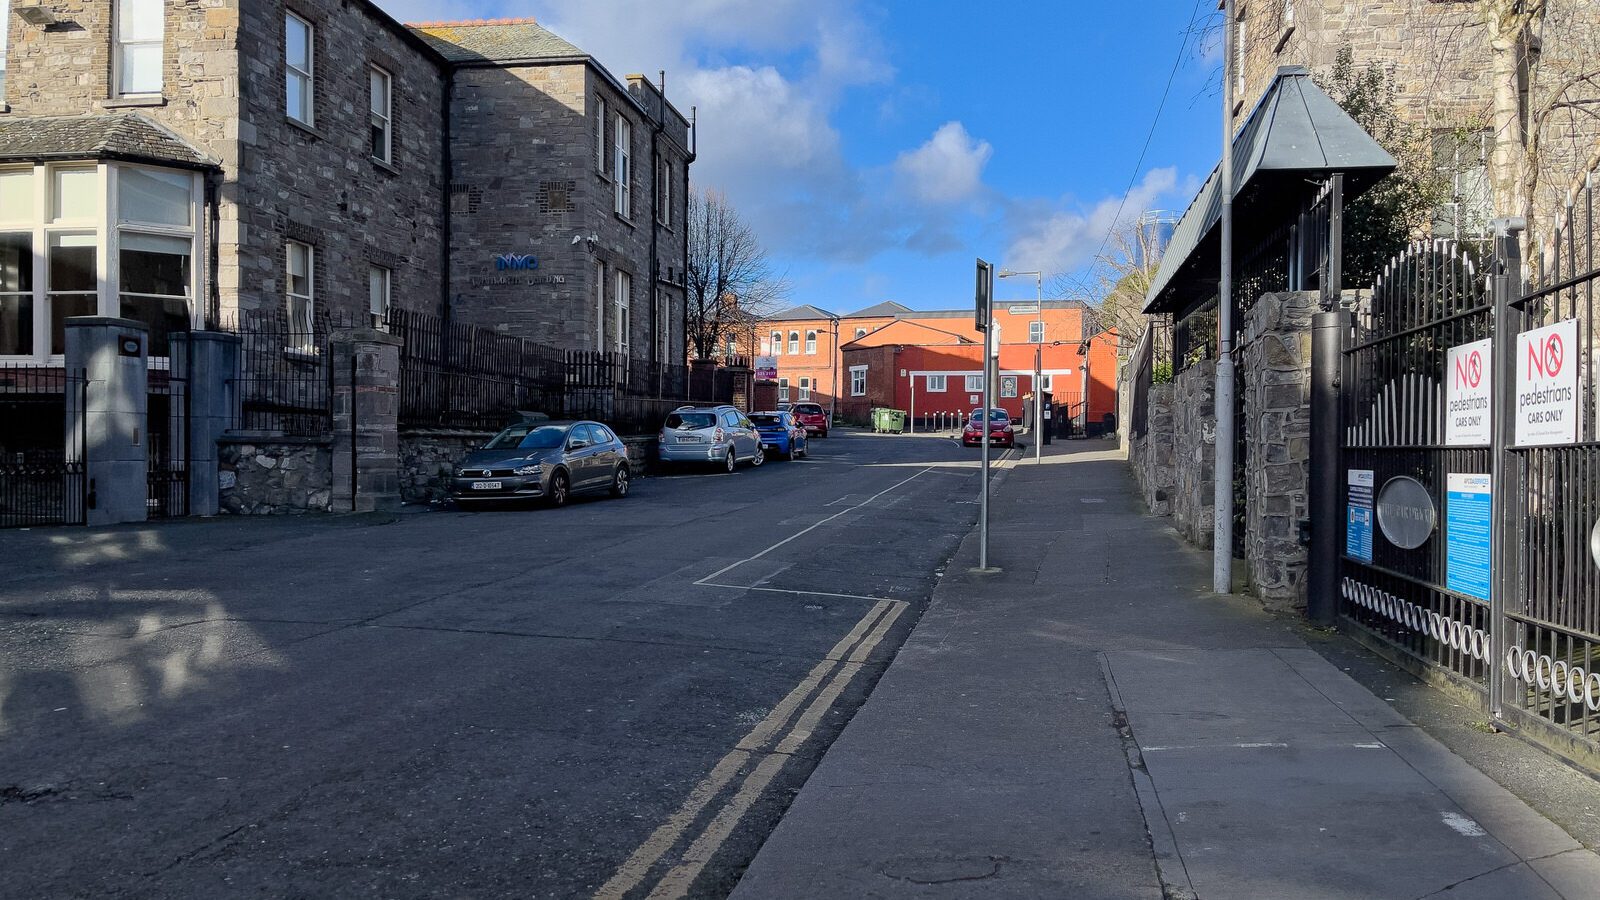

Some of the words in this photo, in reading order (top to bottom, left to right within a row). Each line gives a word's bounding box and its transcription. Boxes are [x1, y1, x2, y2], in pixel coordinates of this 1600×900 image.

[1456, 350, 1482, 391] NO
[1528, 333, 1564, 381] NO
[1449, 392, 1488, 419] pedestrians
[1519, 382, 1572, 413] pedestrians
[1455, 416, 1467, 428] CARS
[1468, 415, 1482, 427] ONLY
[1527, 411, 1543, 424] CARS
[1545, 409, 1564, 422] ONLY
